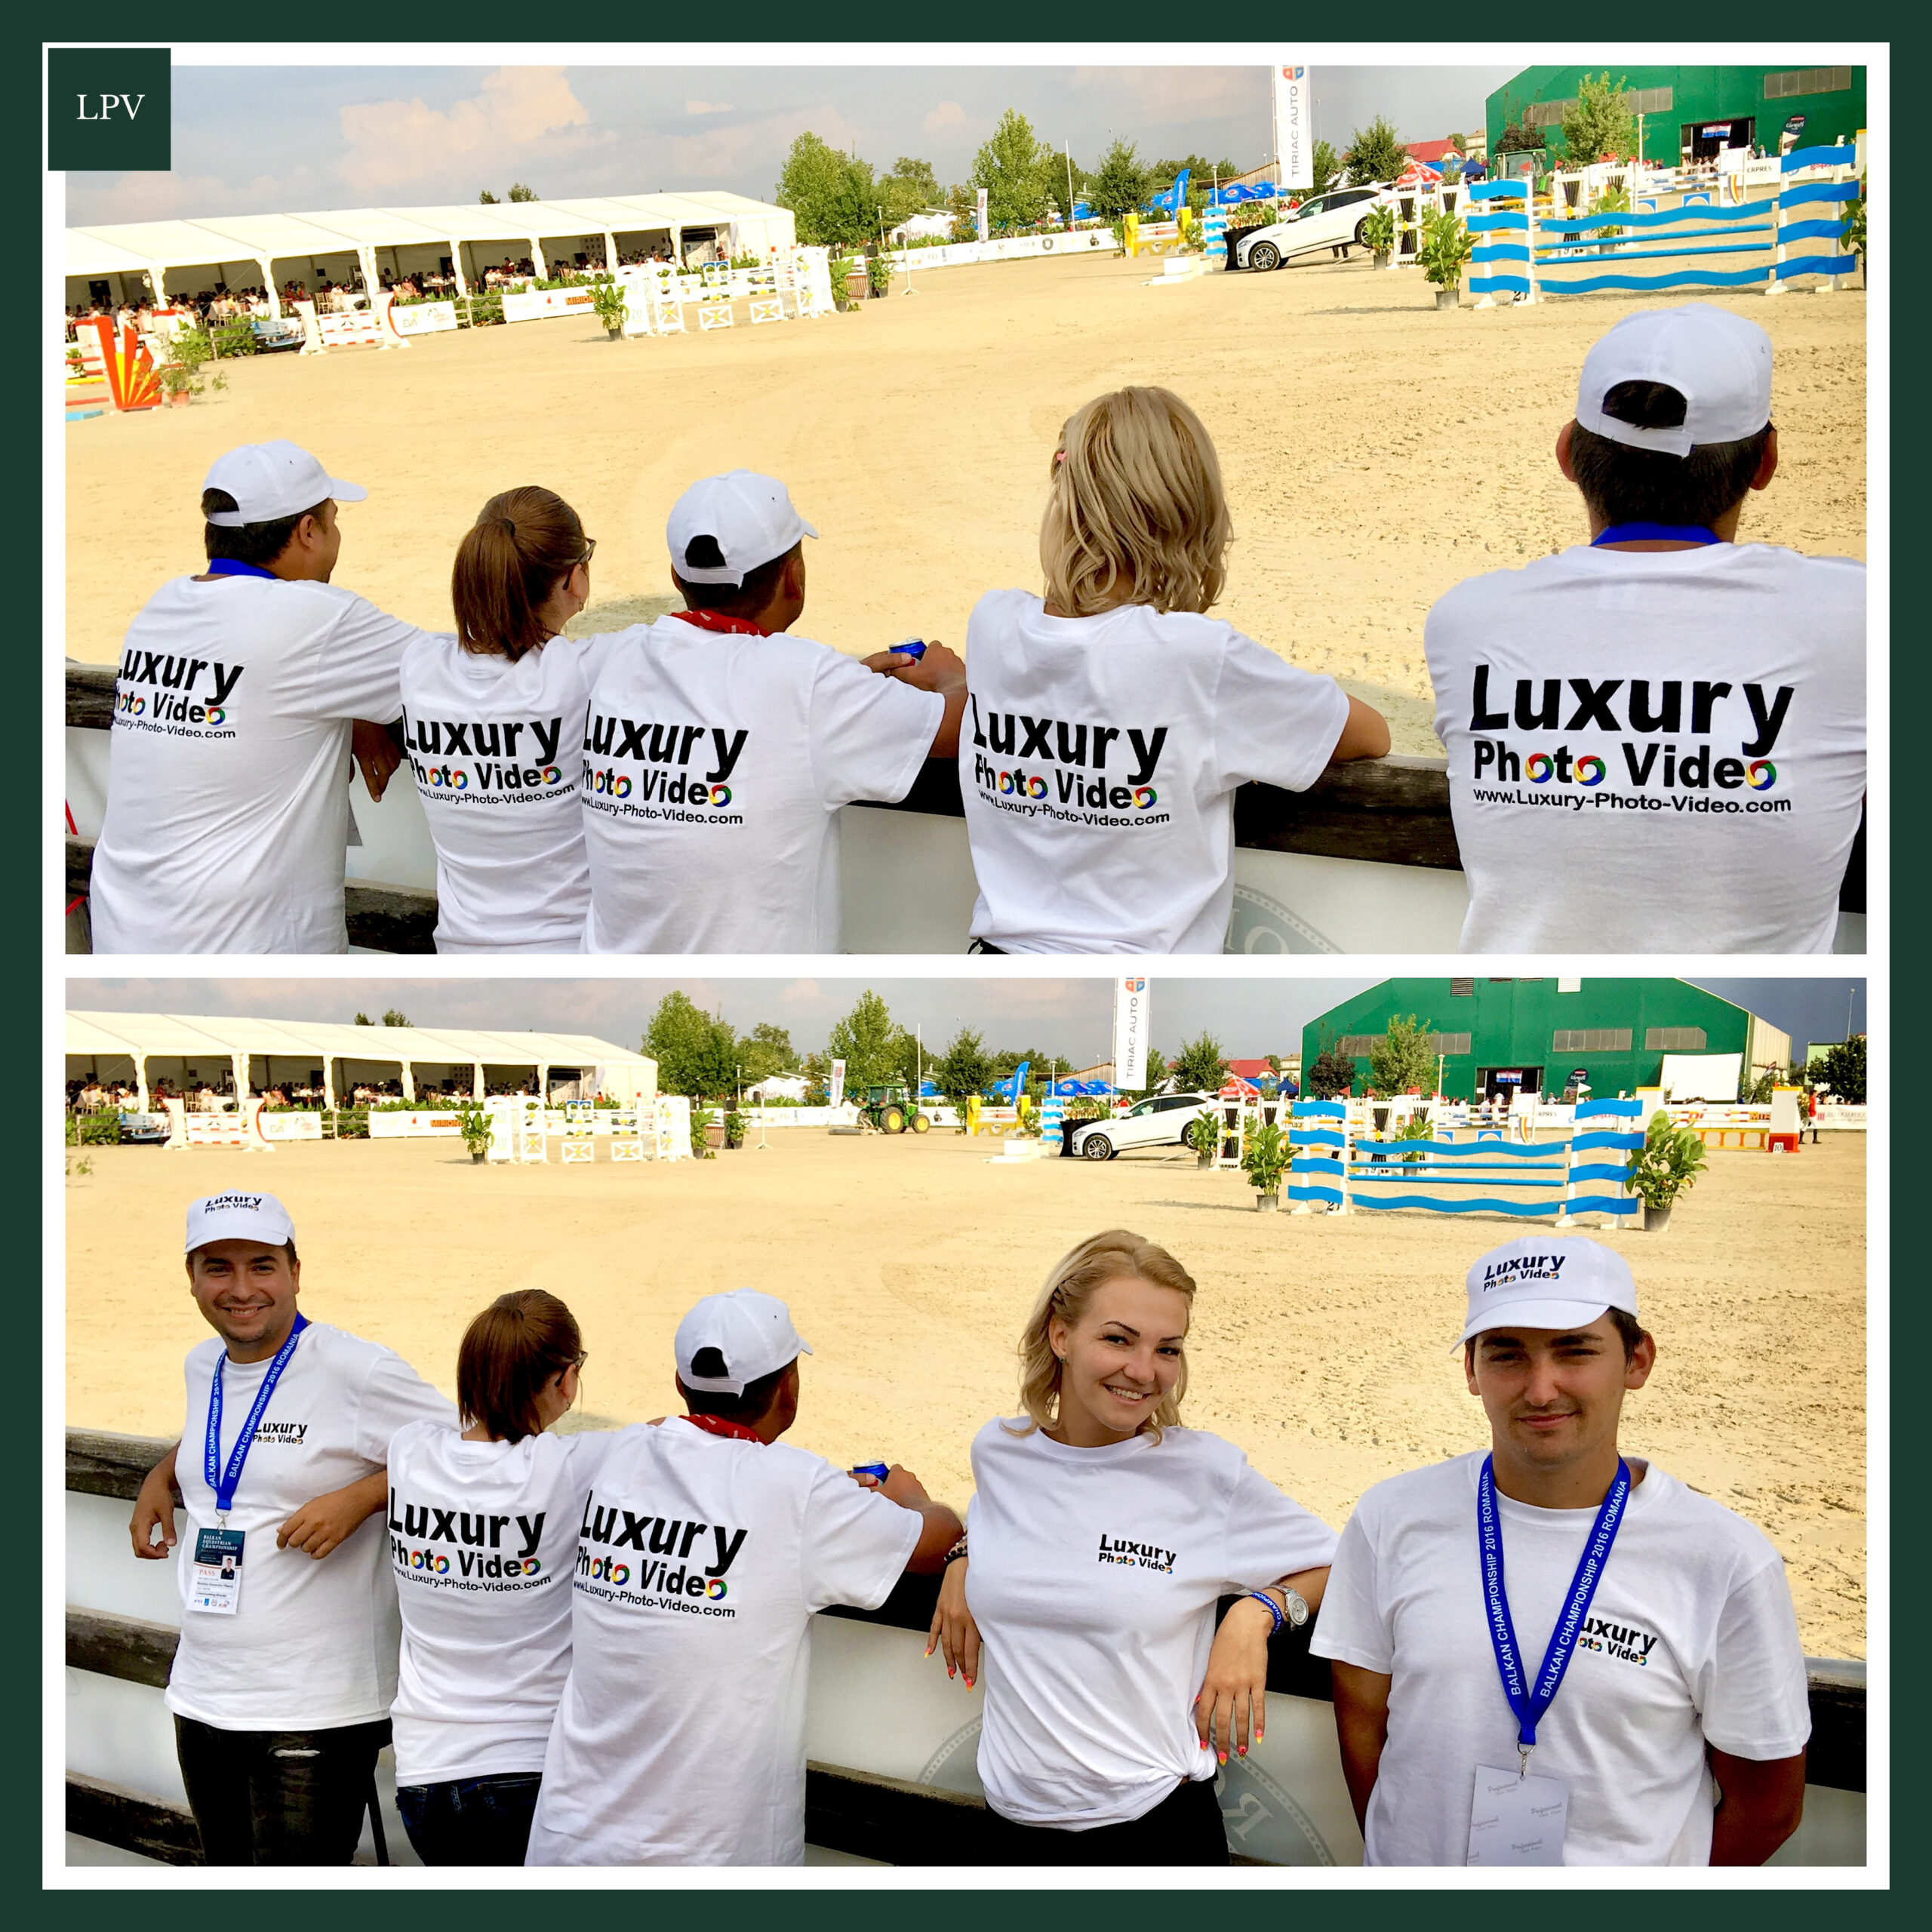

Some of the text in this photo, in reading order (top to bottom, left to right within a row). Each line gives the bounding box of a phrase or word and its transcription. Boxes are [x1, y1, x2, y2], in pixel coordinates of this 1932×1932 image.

[1289, 85, 1299, 177] TIRIAC AUTO
[117, 649, 245, 706] uxury
[116, 685, 226, 726] hoto Video
[1469, 664, 1795, 757] Luxury
[402, 703, 562, 767] Luxury
[583, 699, 749, 783] Luxury
[970, 692, 1169, 786] Luxury
[474, 763, 561, 790] Video
[582, 759, 732, 808] Photo Video
[975, 753, 1158, 810] Photo Video
[1474, 740, 1777, 791] Photo Video
[1473, 789, 1792, 814] www.Luxury-Photo-Video.com
[1126, 997, 1138, 1079] TIRIAC AUTO
[205, 1196, 262, 1207] Luxury
[205, 1202, 259, 1214] Photo Video
[1484, 1255, 1566, 1281] Luxury
[1484, 1269, 1560, 1292] Photo Video
[208, 1397, 220, 1454] CHAMPIONSHIP
[229, 1333, 300, 1478] BALKAN CHAMPIONSHIP 2016 ROMANIA
[278, 1435, 303, 1444] Video
[389, 1487, 546, 1558] Luxury
[580, 1490, 748, 1577] Luxury
[391, 1535, 540, 1578] Photo Video
[575, 1546, 728, 1600] Photo Video
[1099, 1534, 1177, 1566] Luxury
[1099, 1552, 1173, 1574] Photo Video
[1482, 1471, 1521, 1695] BALKAN CHAMPIONSHIP 2016 ROMANIA
[1540, 1480, 1627, 1698] BALKAN CHAMPIONSHIP 2016 ROMANIA
[1577, 1637, 1647, 1666] oto Video
[1580, 1617, 1657, 1656] uxury
